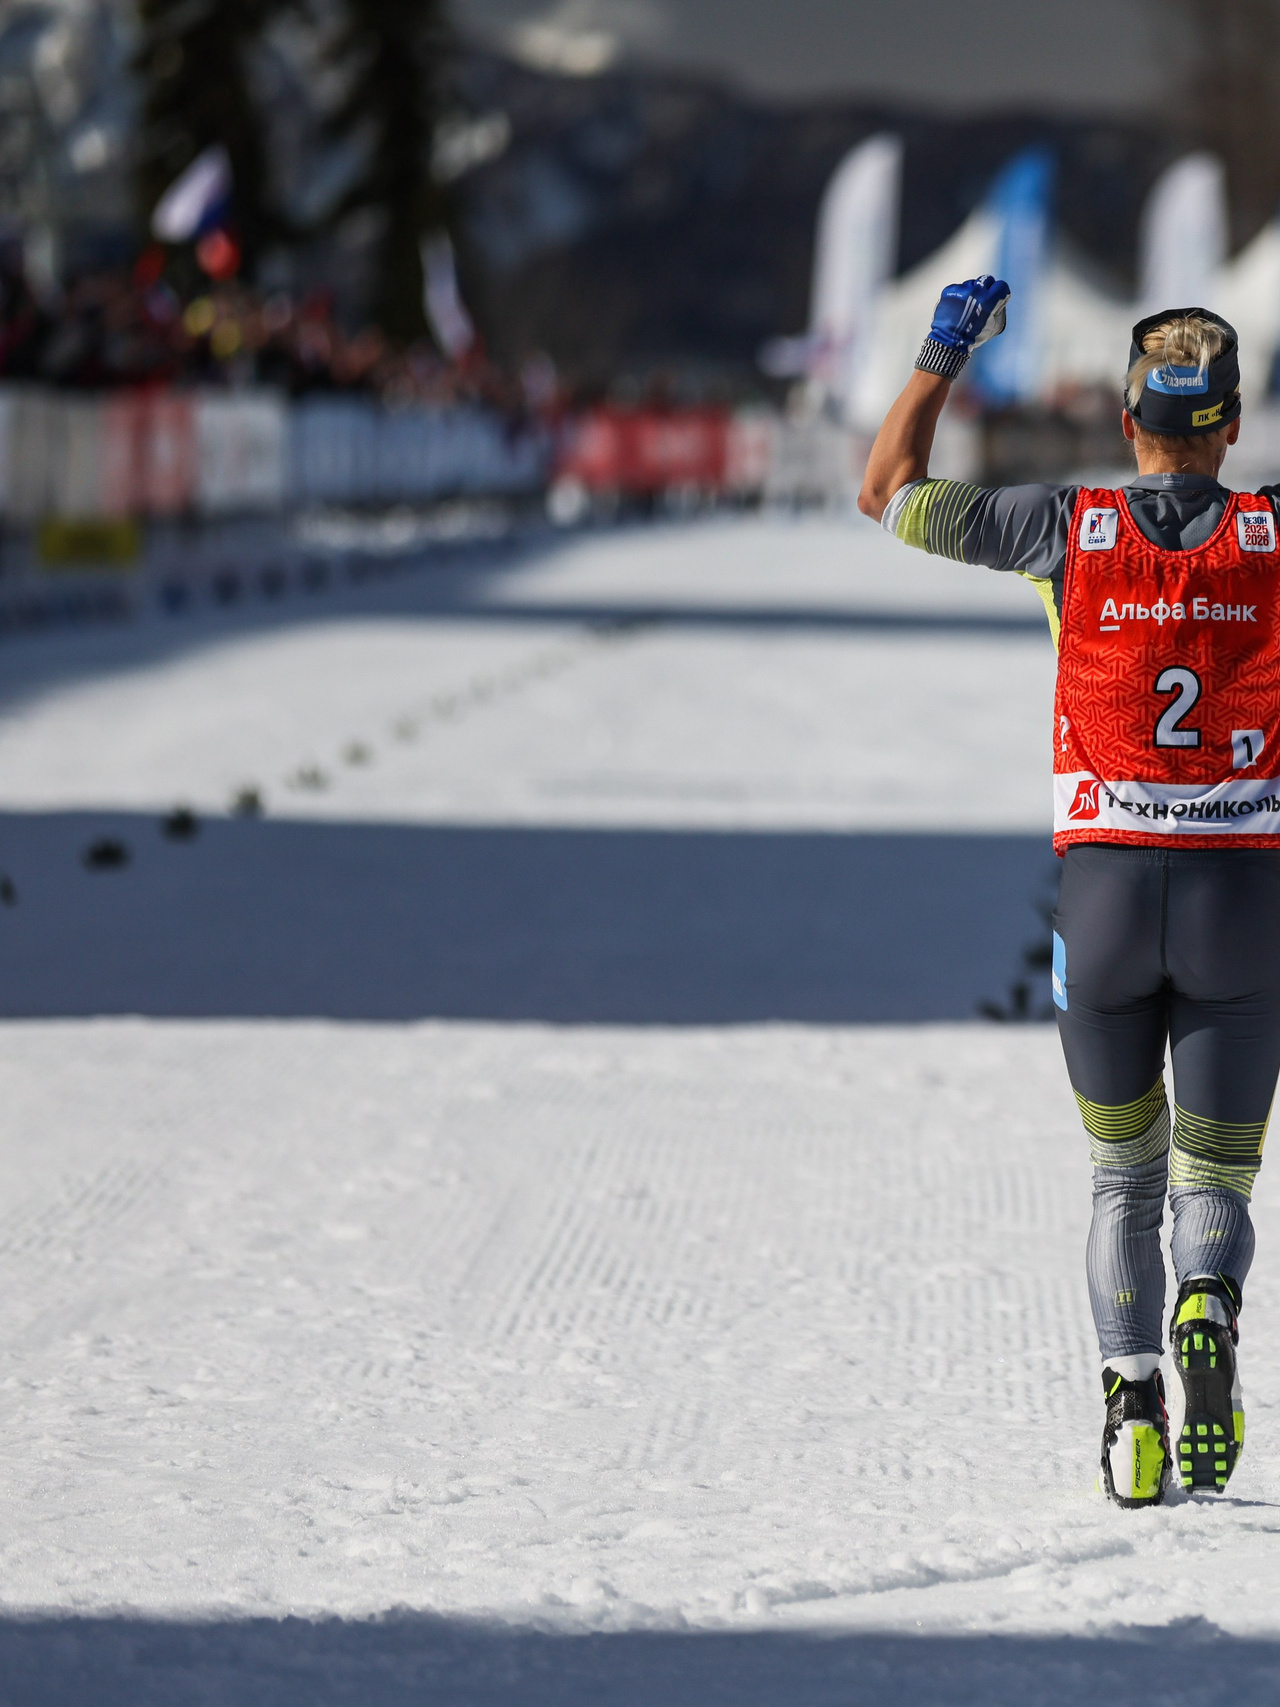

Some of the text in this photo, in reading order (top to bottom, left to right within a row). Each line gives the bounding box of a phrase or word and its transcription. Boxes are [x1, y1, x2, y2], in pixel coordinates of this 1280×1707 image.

[1197, 412, 1210, 423] ЛК
[1243, 516, 1267, 525] СЕЗОН
[1244, 524, 1268, 535] 2025
[1245, 534, 1269, 546] 2026
[1100, 597, 1257, 625] Альфа Банк
[1154, 665, 1202, 749] 2
[1242, 736, 1252, 762] 1
